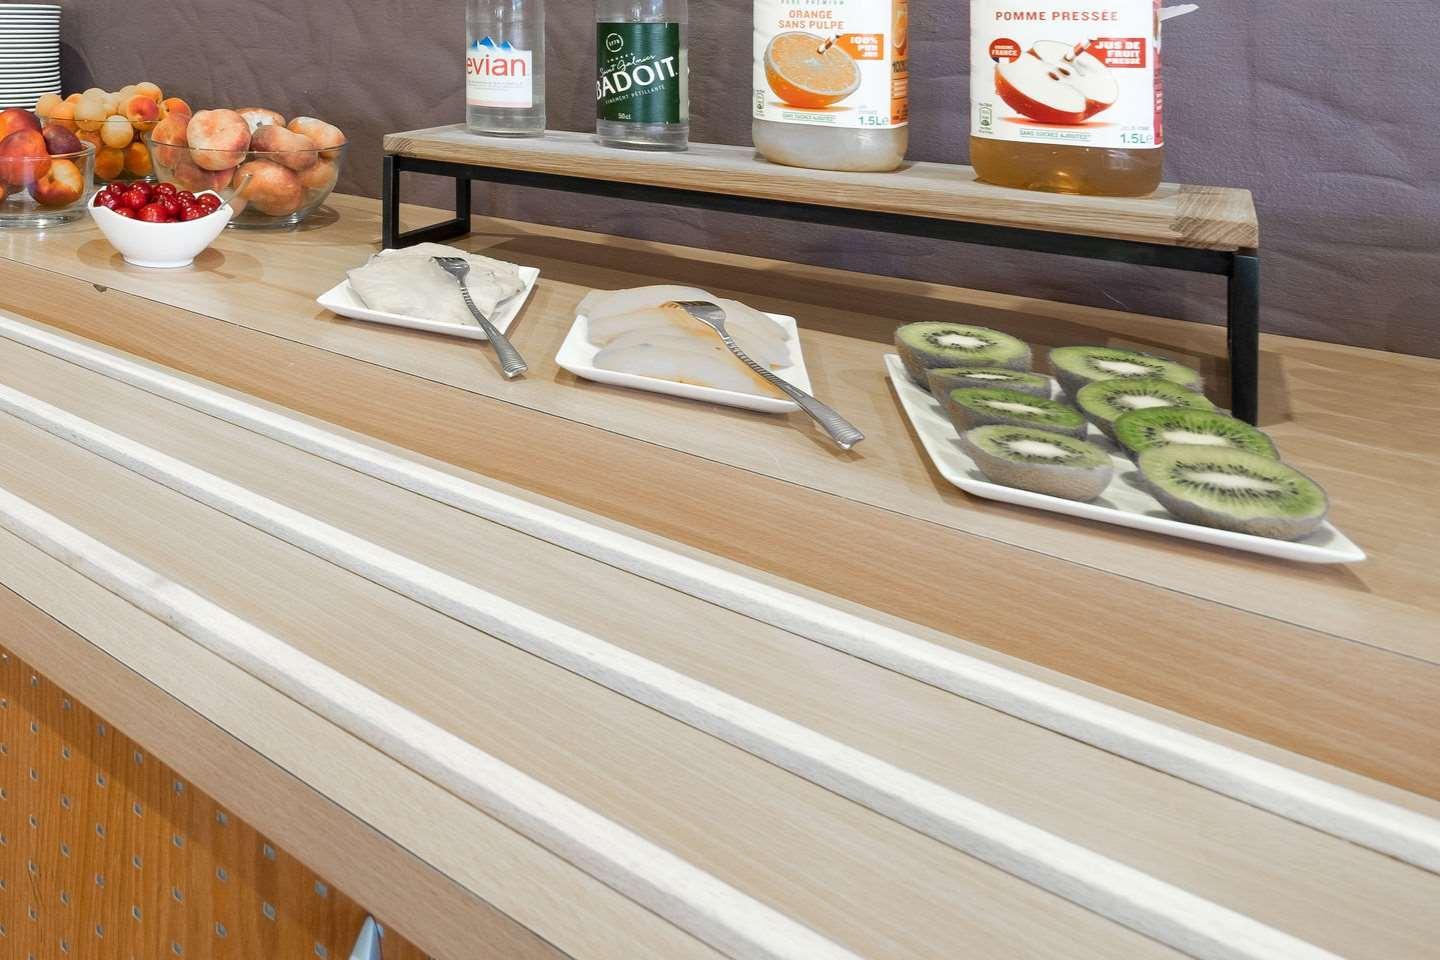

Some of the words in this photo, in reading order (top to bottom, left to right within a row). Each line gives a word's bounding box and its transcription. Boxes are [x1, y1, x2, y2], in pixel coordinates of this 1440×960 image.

[788, 10, 833, 19] ORANGE
[995, 11, 1046, 21] POMME
[777, 19, 806, 29] SANS
[808, 20, 845, 30] PULPE
[1095, 40, 1123, 50] JUS
[1125, 41, 1141, 50] DE
[1107, 50, 1141, 58] FRUIT
[466, 54, 527, 77] evian
